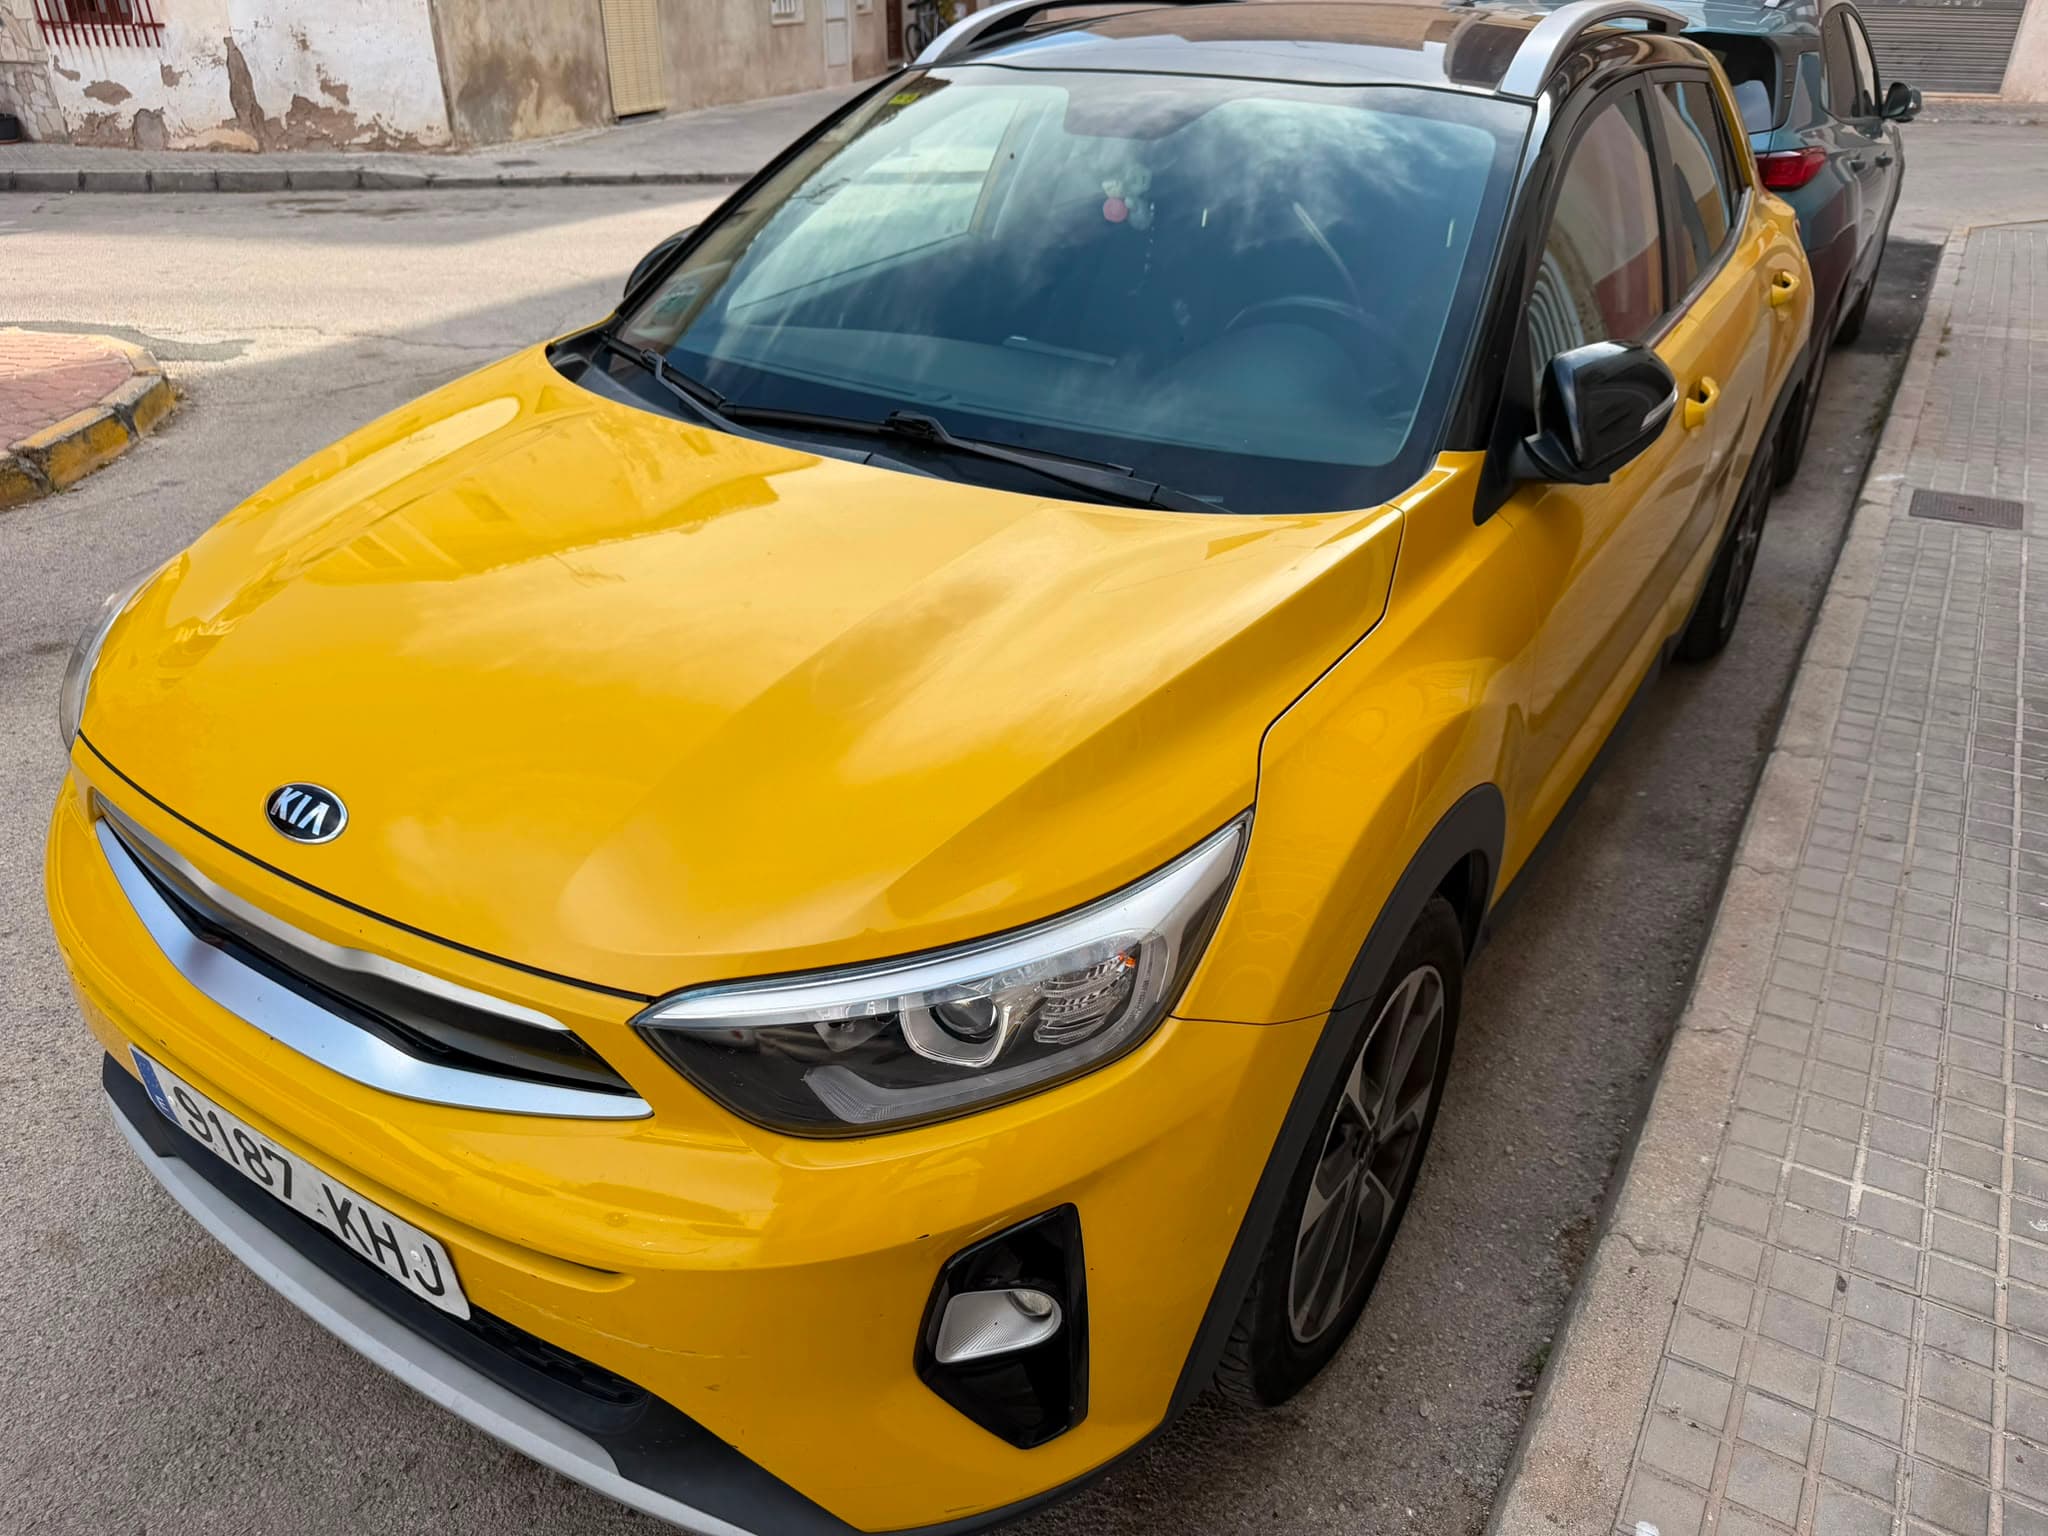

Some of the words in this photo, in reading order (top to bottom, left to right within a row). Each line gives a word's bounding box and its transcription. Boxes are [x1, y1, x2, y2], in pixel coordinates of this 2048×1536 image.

[270, 787, 330, 836] KIA
[173, 1086, 292, 1200] 9187
[321, 1183, 445, 1297] KHJ
